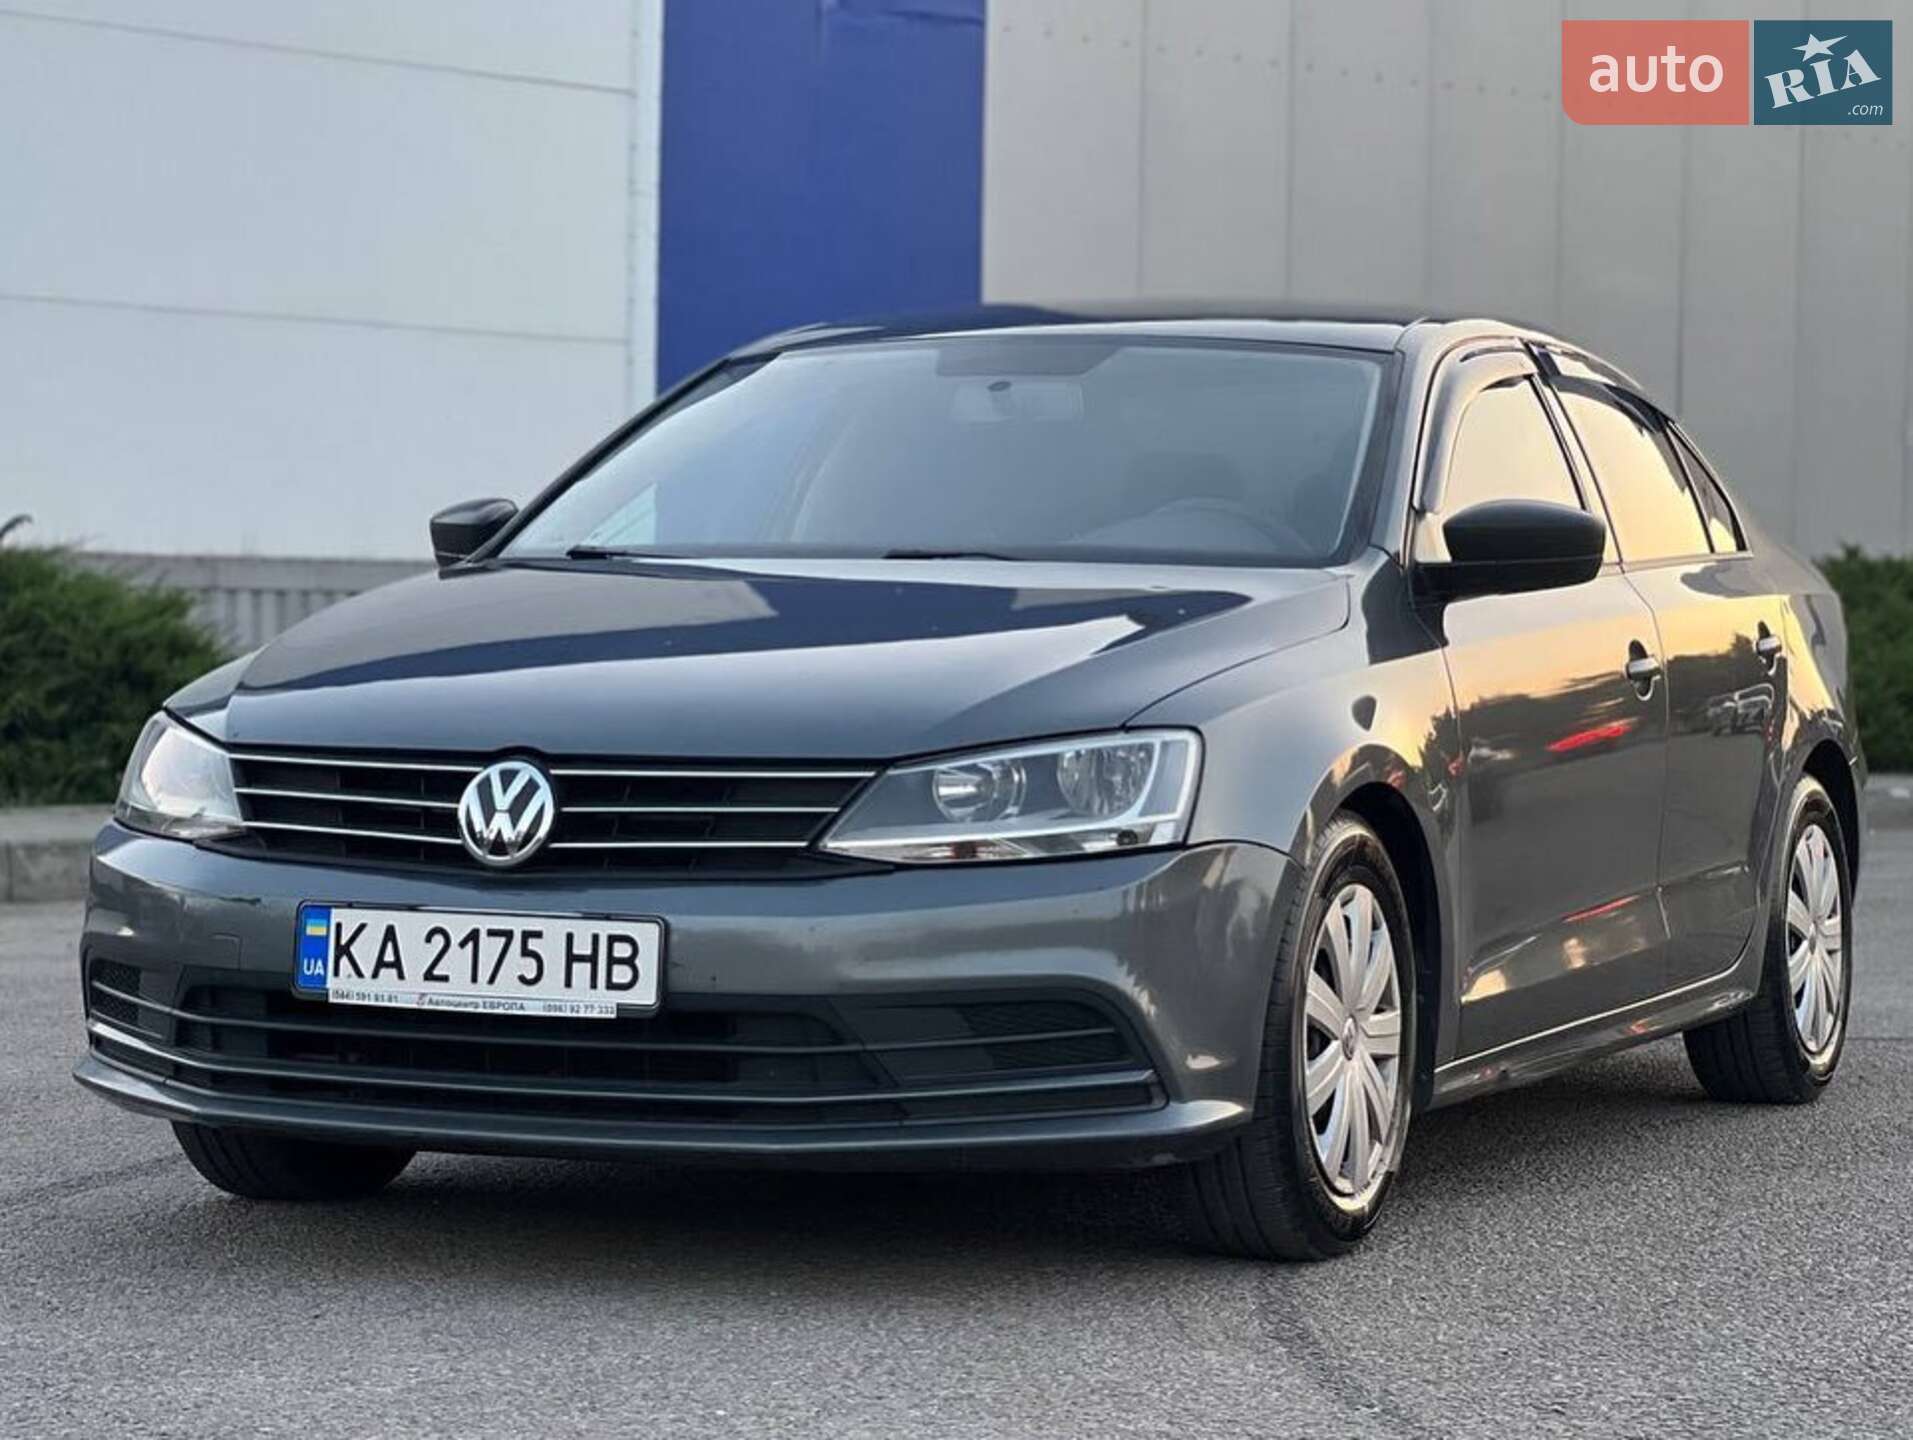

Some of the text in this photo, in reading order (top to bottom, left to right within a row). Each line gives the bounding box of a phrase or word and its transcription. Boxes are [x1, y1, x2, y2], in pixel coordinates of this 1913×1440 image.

[333, 922, 640, 991] KA 2175 HB
[303, 957, 325, 976] UA
[482, 1000, 526, 1011] ЕВРОПА
